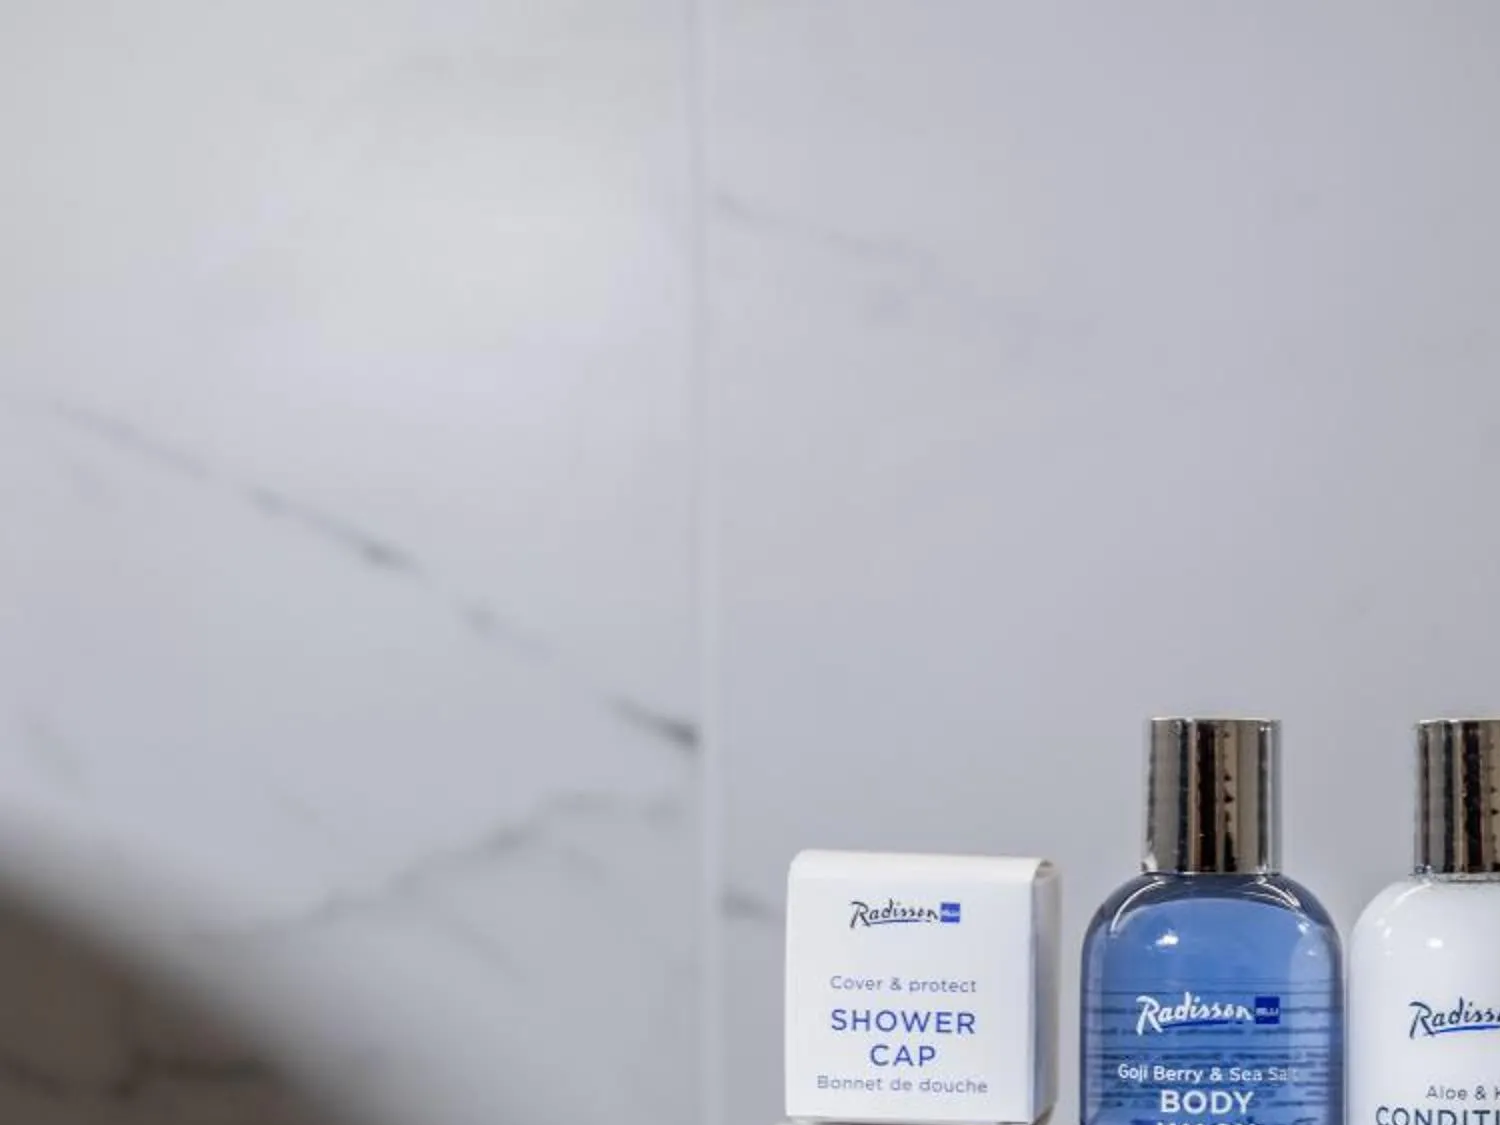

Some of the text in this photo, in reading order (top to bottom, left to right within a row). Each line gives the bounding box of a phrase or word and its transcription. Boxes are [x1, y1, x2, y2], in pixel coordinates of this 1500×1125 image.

[850, 898, 939, 929] Radisson
[830, 975, 977, 993] Cover & protect
[830, 1008, 977, 1034] SHOWER
[1135, 991, 1254, 1036] Radisson
[870, 1044, 937, 1067] CAP
[817, 1075, 988, 1094] Bonnet de douche
[1117, 1063, 1149, 1081] Goji
[1153, 1065, 1204, 1084] Berry
[1209, 1066, 1223, 1081] &
[1229, 1066, 1263, 1081] Sea
[1159, 1089, 1254, 1115] BODY
[1426, 1085, 1468, 1101] Aloe
[1474, 1086, 1487, 1101] &
